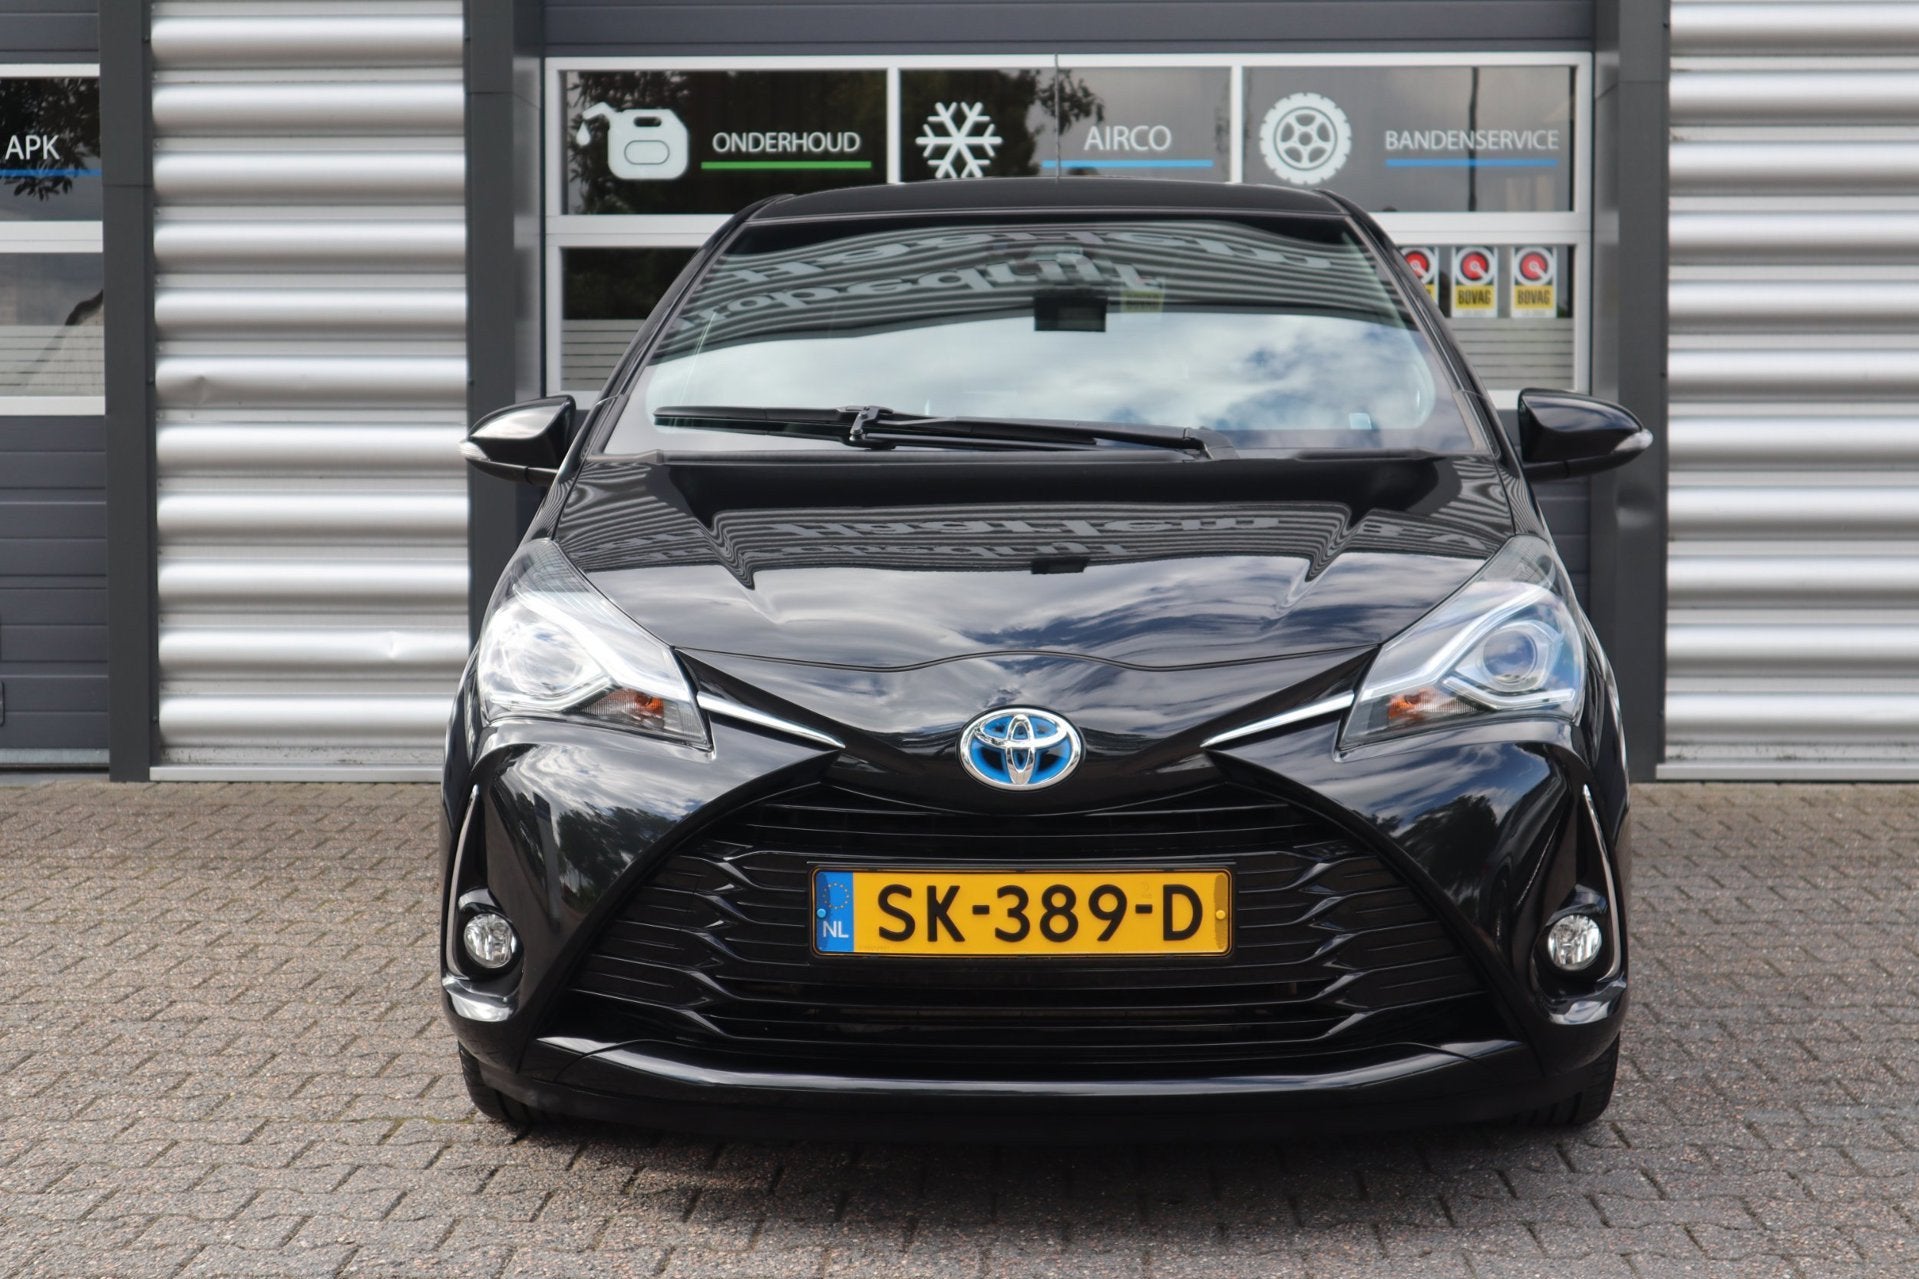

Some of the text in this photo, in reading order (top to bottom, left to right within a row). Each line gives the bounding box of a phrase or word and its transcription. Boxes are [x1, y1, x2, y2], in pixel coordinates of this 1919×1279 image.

[4, 134, 61, 161] APK
[711, 131, 862, 154] ONDERHOUD
[1084, 125, 1172, 151] AIRCO
[1385, 130, 1559, 151] BANDENSERVICE
[1458, 290, 1491, 305] BOVAG
[1517, 290, 1550, 305] BOVAG
[878, 883, 1203, 943] SK-389-D
[822, 921, 849, 938] NL
